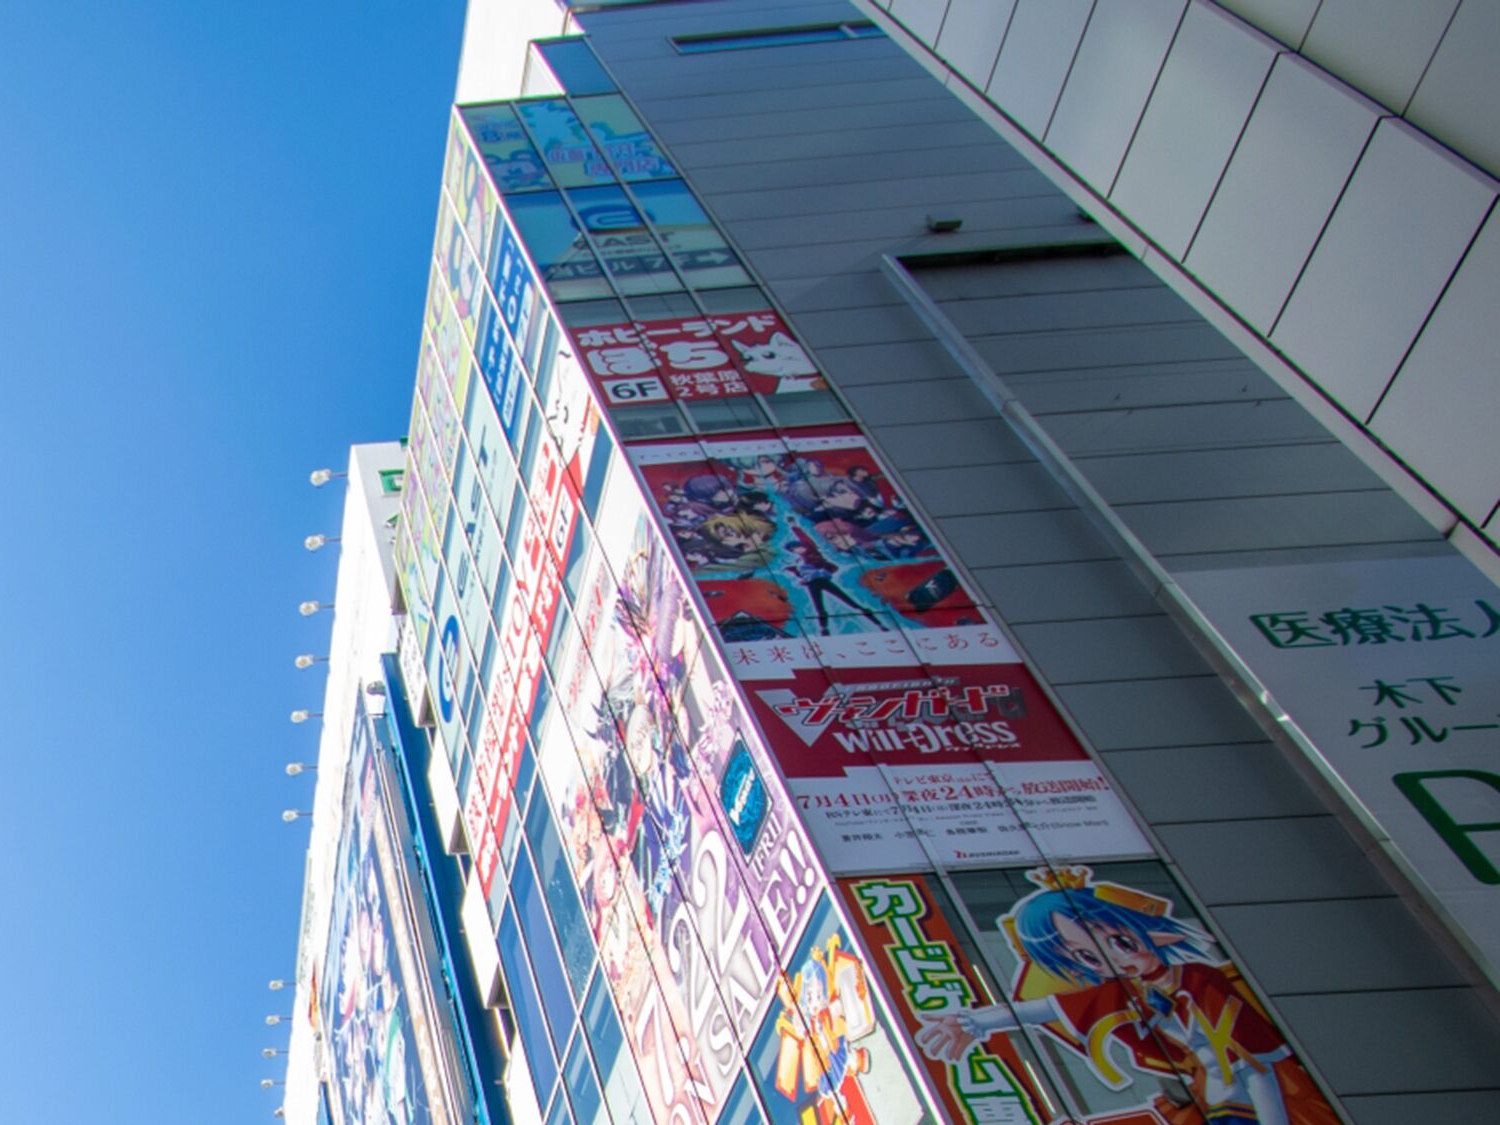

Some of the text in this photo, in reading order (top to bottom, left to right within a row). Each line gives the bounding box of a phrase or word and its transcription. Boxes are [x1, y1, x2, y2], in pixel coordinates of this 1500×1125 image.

[578, 314, 777, 346] ホビーランド
[587, 340, 729, 377] ぽち
[611, 380, 659, 400] 6F
[670, 370, 740, 386] 秋葉原
[677, 382, 748, 398] 2号店
[734, 631, 1000, 666] 未来は、ここにある
[1358, 675, 1463, 709] 木下
[1347, 714, 1500, 750] グルー
